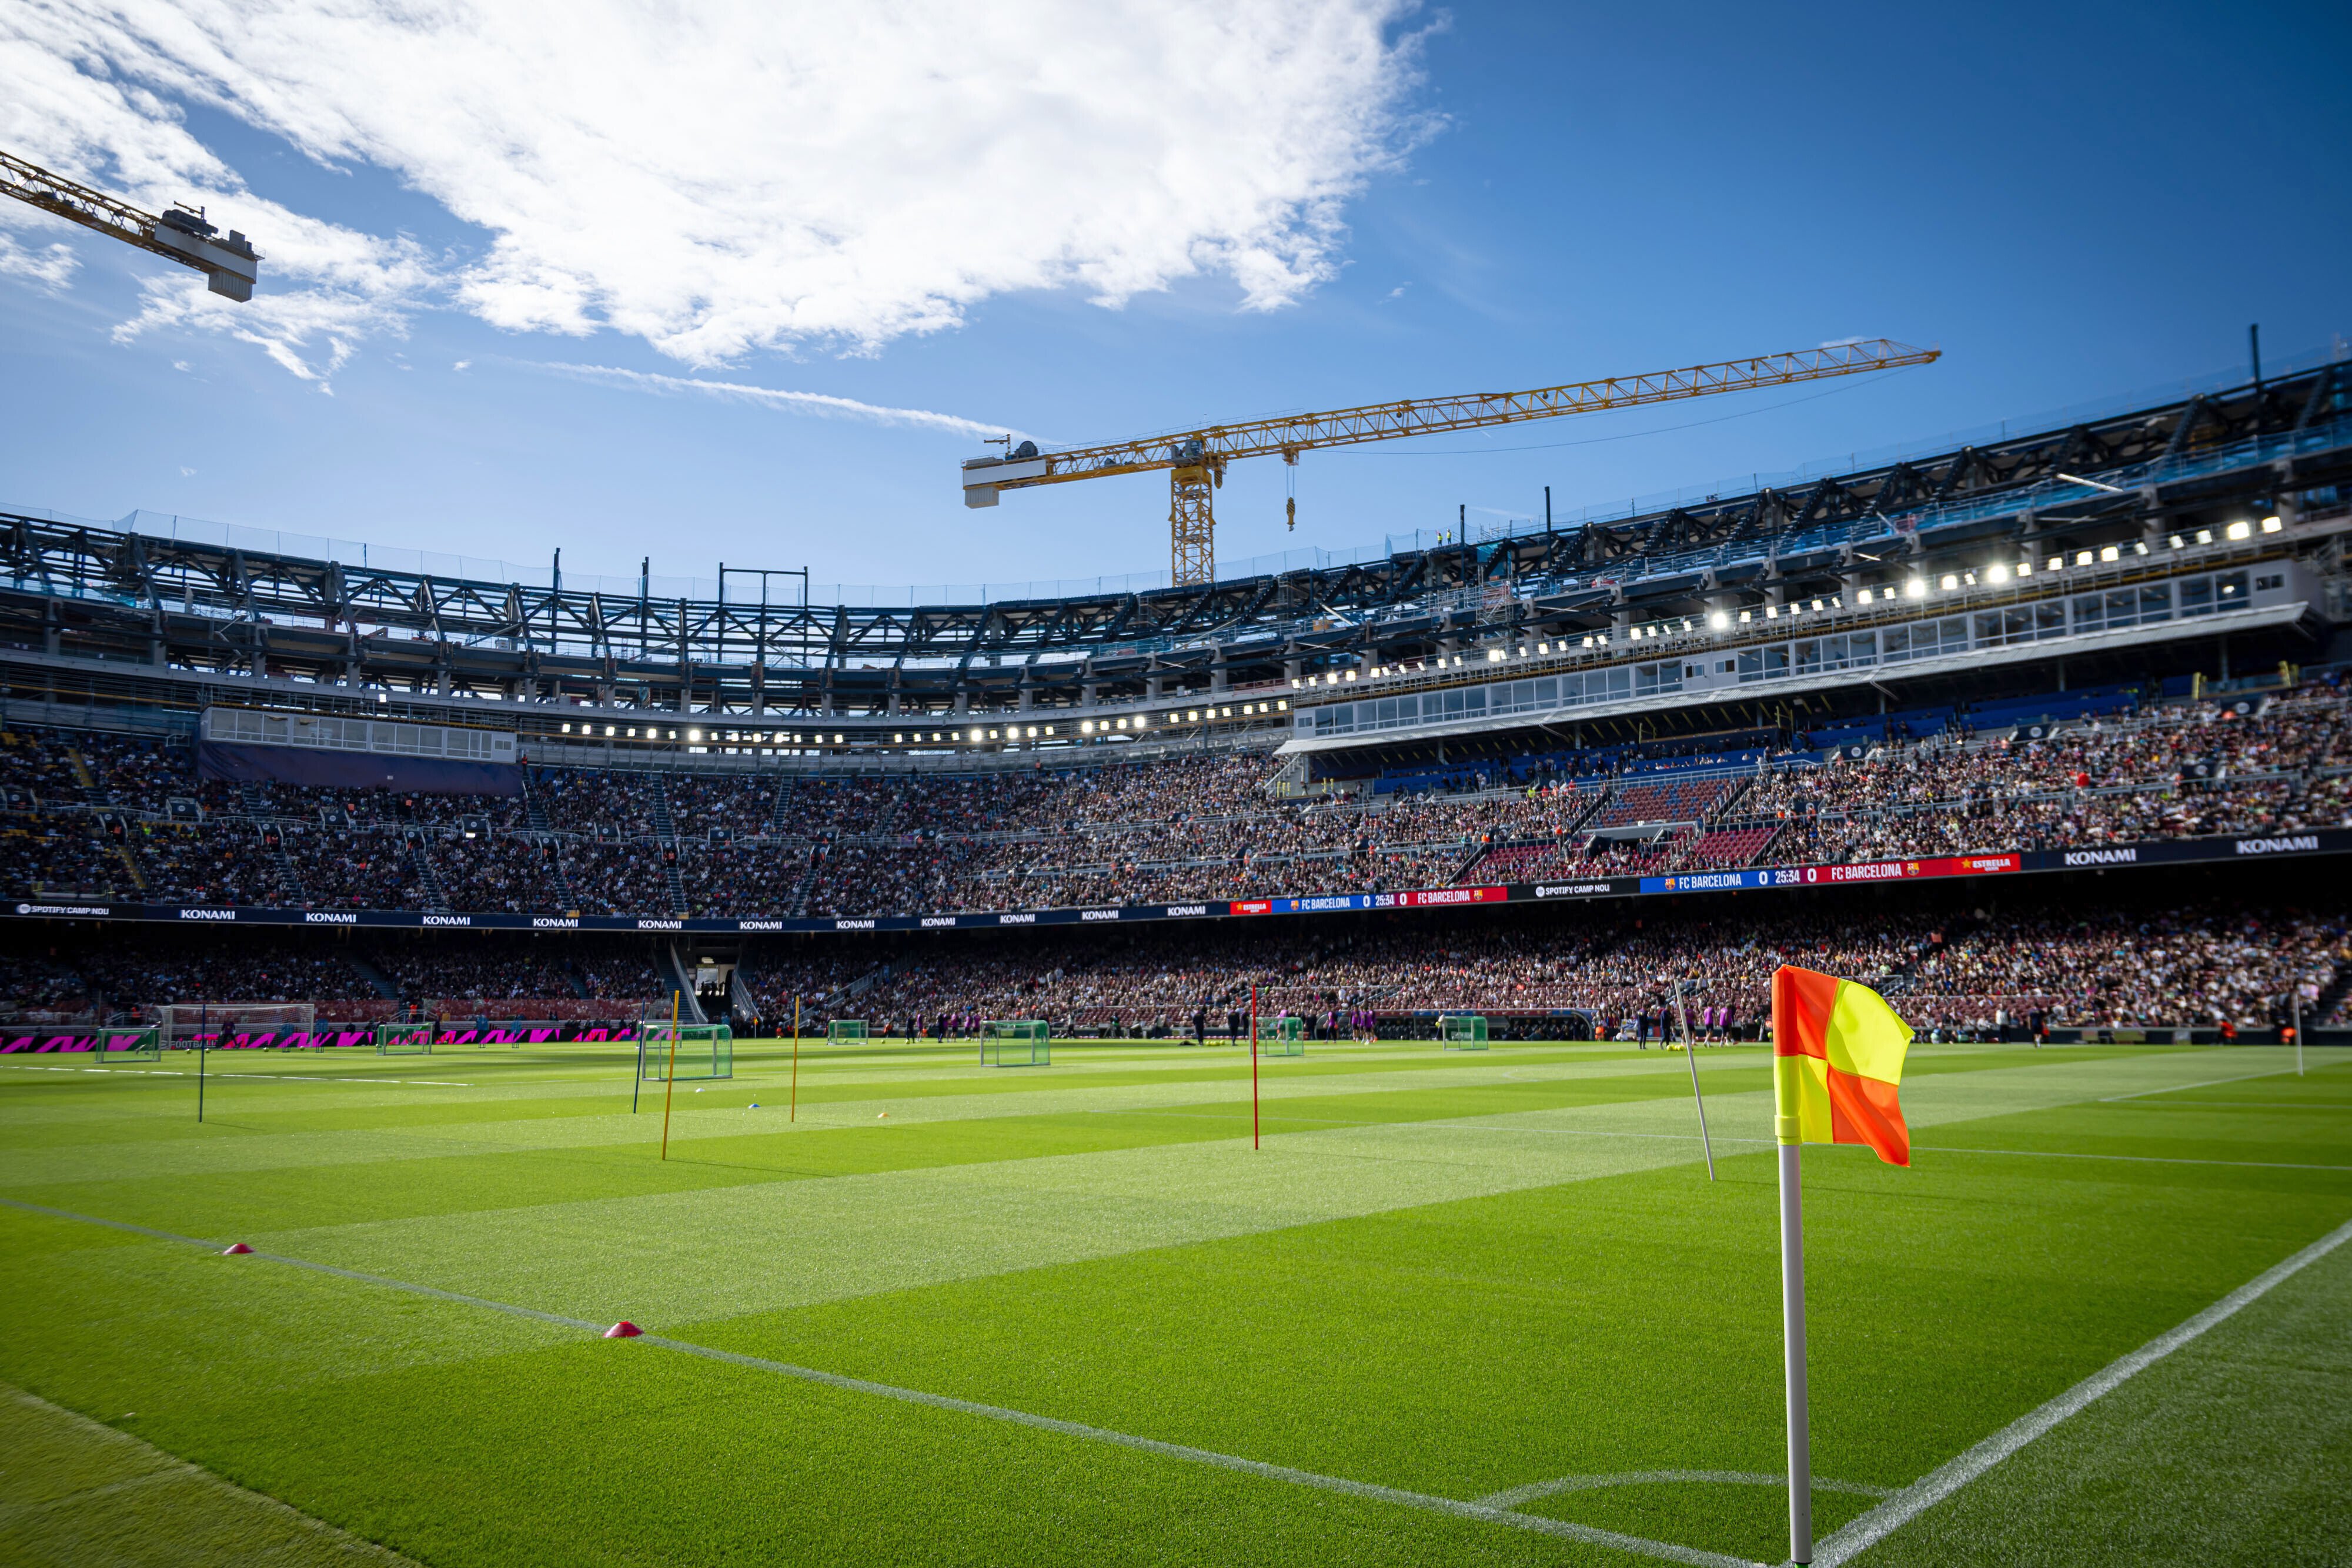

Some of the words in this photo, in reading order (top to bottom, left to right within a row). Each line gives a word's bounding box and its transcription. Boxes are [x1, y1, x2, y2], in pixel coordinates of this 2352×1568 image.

[2236, 835, 2318, 854] KONAMI
[2064, 848, 2136, 865] KONAMI
[1972, 858, 2011, 868] ESTRELLA
[1679, 877, 1689, 889] FC
[1691, 873, 1742, 888] BARCELONA
[1759, 871, 1768, 885] 0
[1775, 870, 1800, 883] 25:34
[1808, 868, 1816, 882] 0
[1832, 867, 1843, 880] FC
[1845, 863, 1902, 879] BARCELONA
[1545, 886, 1573, 895] SPOTIFY
[1574, 885, 1593, 893] CAMP
[1302, 900, 1310, 910] FC
[1311, 897, 1351, 910] BARCELONA
[1363, 895, 1370, 907] 0
[1375, 895, 1394, 906] 25:34
[1400, 893, 1407, 905] 0
[1418, 892, 1426, 904] FC
[1428, 891, 1470, 903] BARCELONA
[31, 905, 66, 914] SPOTIFY
[1168, 906, 1205, 916] KONAMI
[181, 910, 235, 920] KONAMI
[306, 912, 357, 923] KONAMI
[1000, 914, 1035, 923] KONAMI
[1082, 910, 1118, 920] KONAMI
[423, 916, 470, 925] KONAMI
[533, 918, 579, 928] KONAMI
[638, 920, 682, 930] KONAMI
[837, 920, 874, 929] KONAMI
[921, 918, 955, 927] KONAMI
